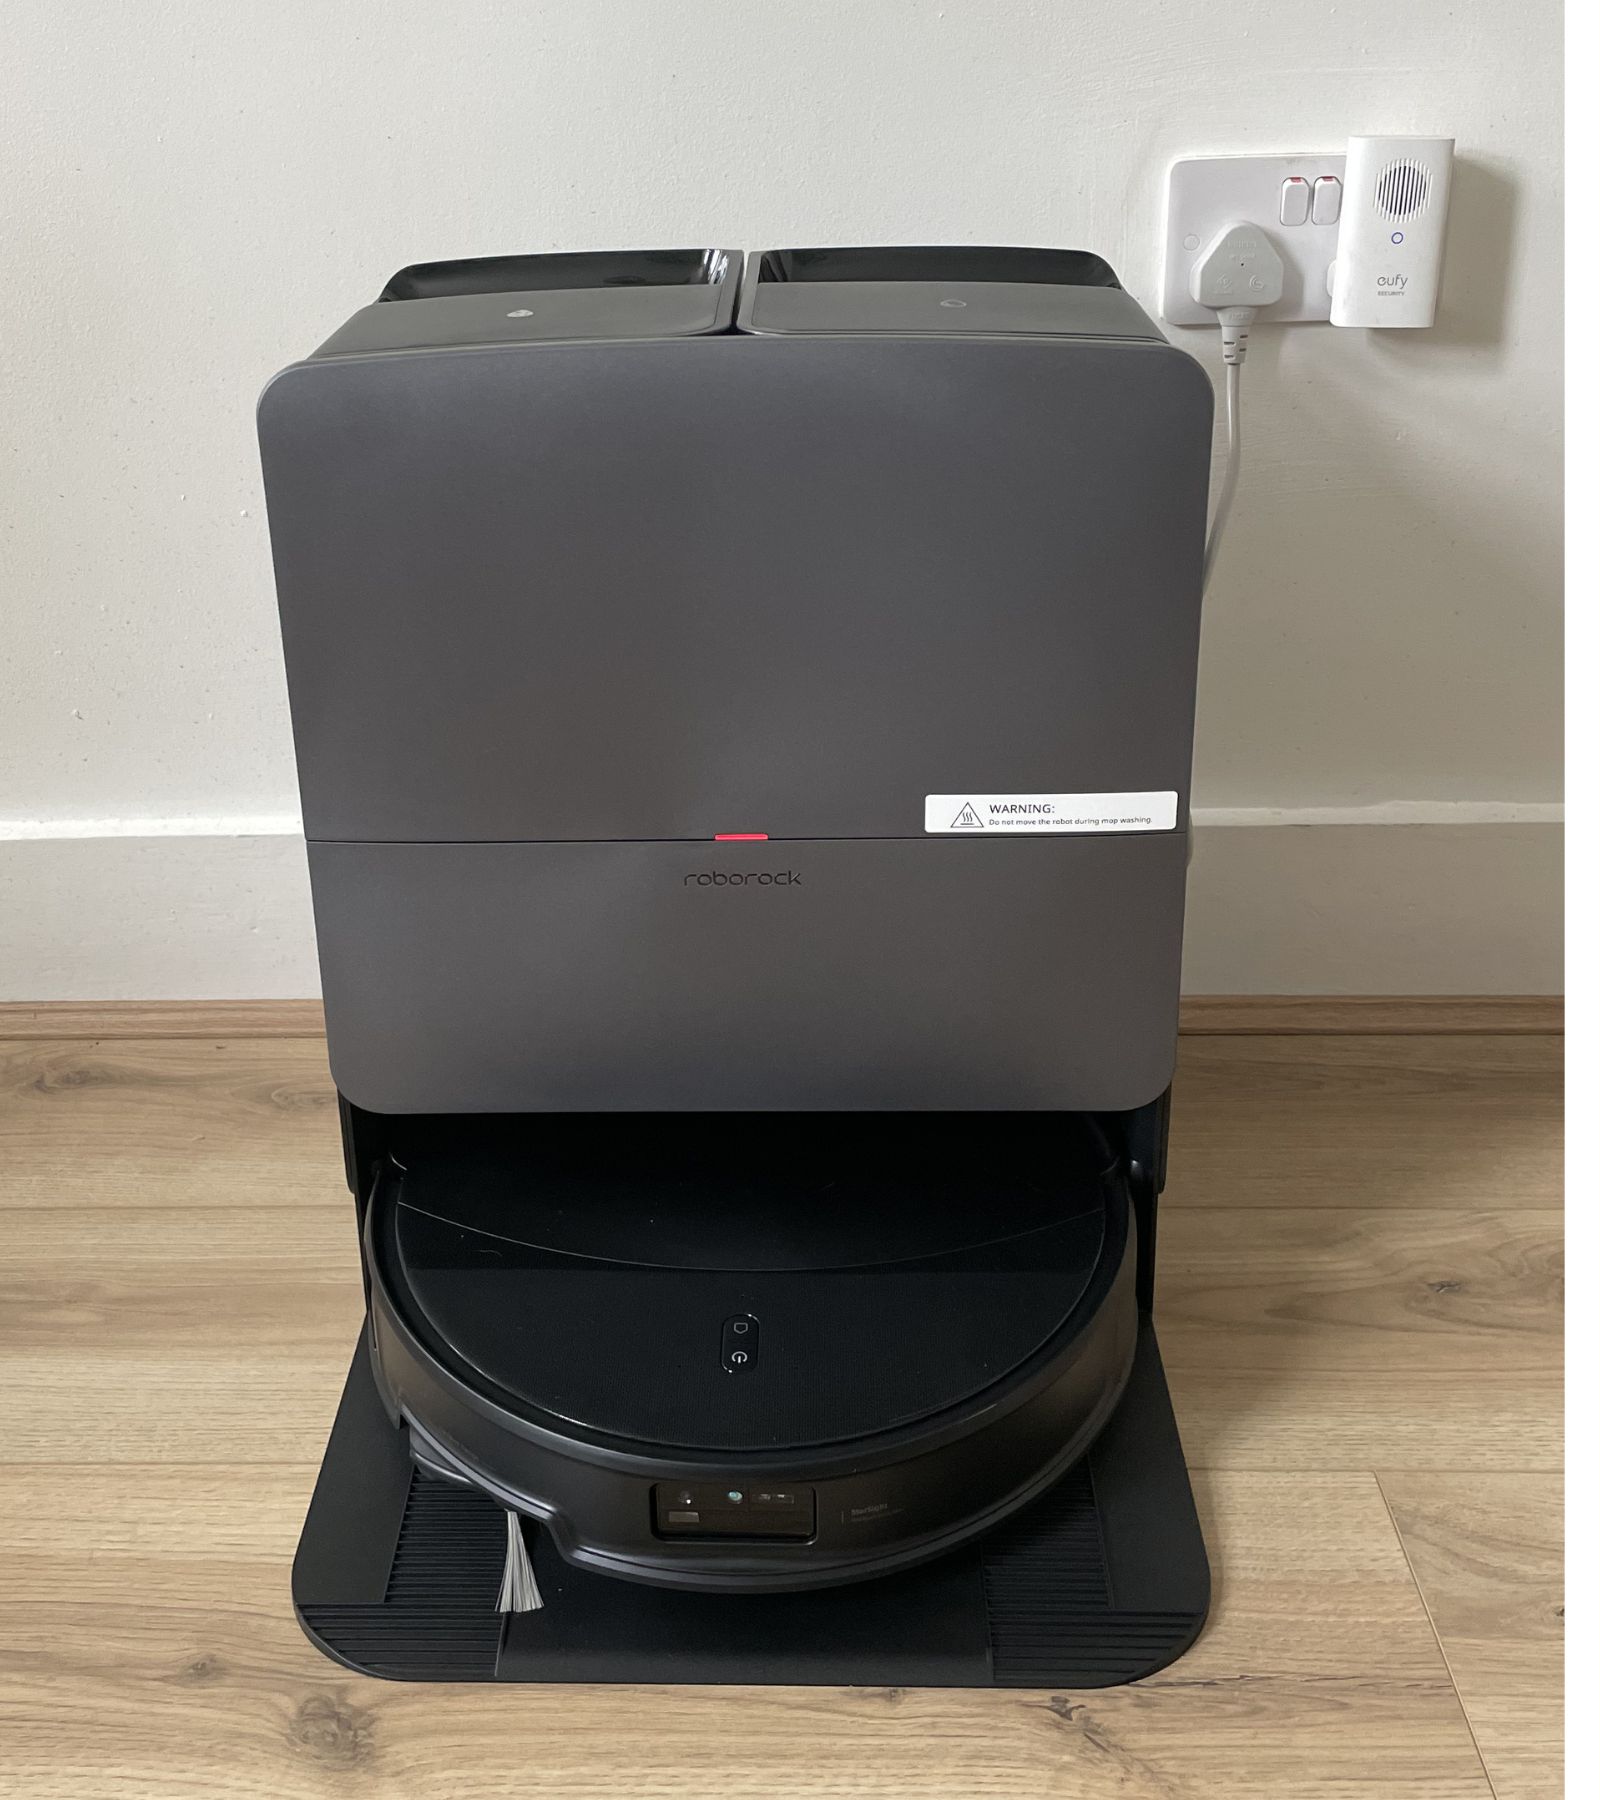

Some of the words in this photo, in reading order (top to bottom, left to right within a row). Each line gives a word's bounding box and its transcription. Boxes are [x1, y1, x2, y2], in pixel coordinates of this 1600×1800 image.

[1377, 273, 1408, 289] eufy
[989, 804, 1055, 814] WARNING:
[1074, 818, 1099, 826] during
[1120, 816, 1152, 824] washing.
[684, 870, 802, 886] roborock
